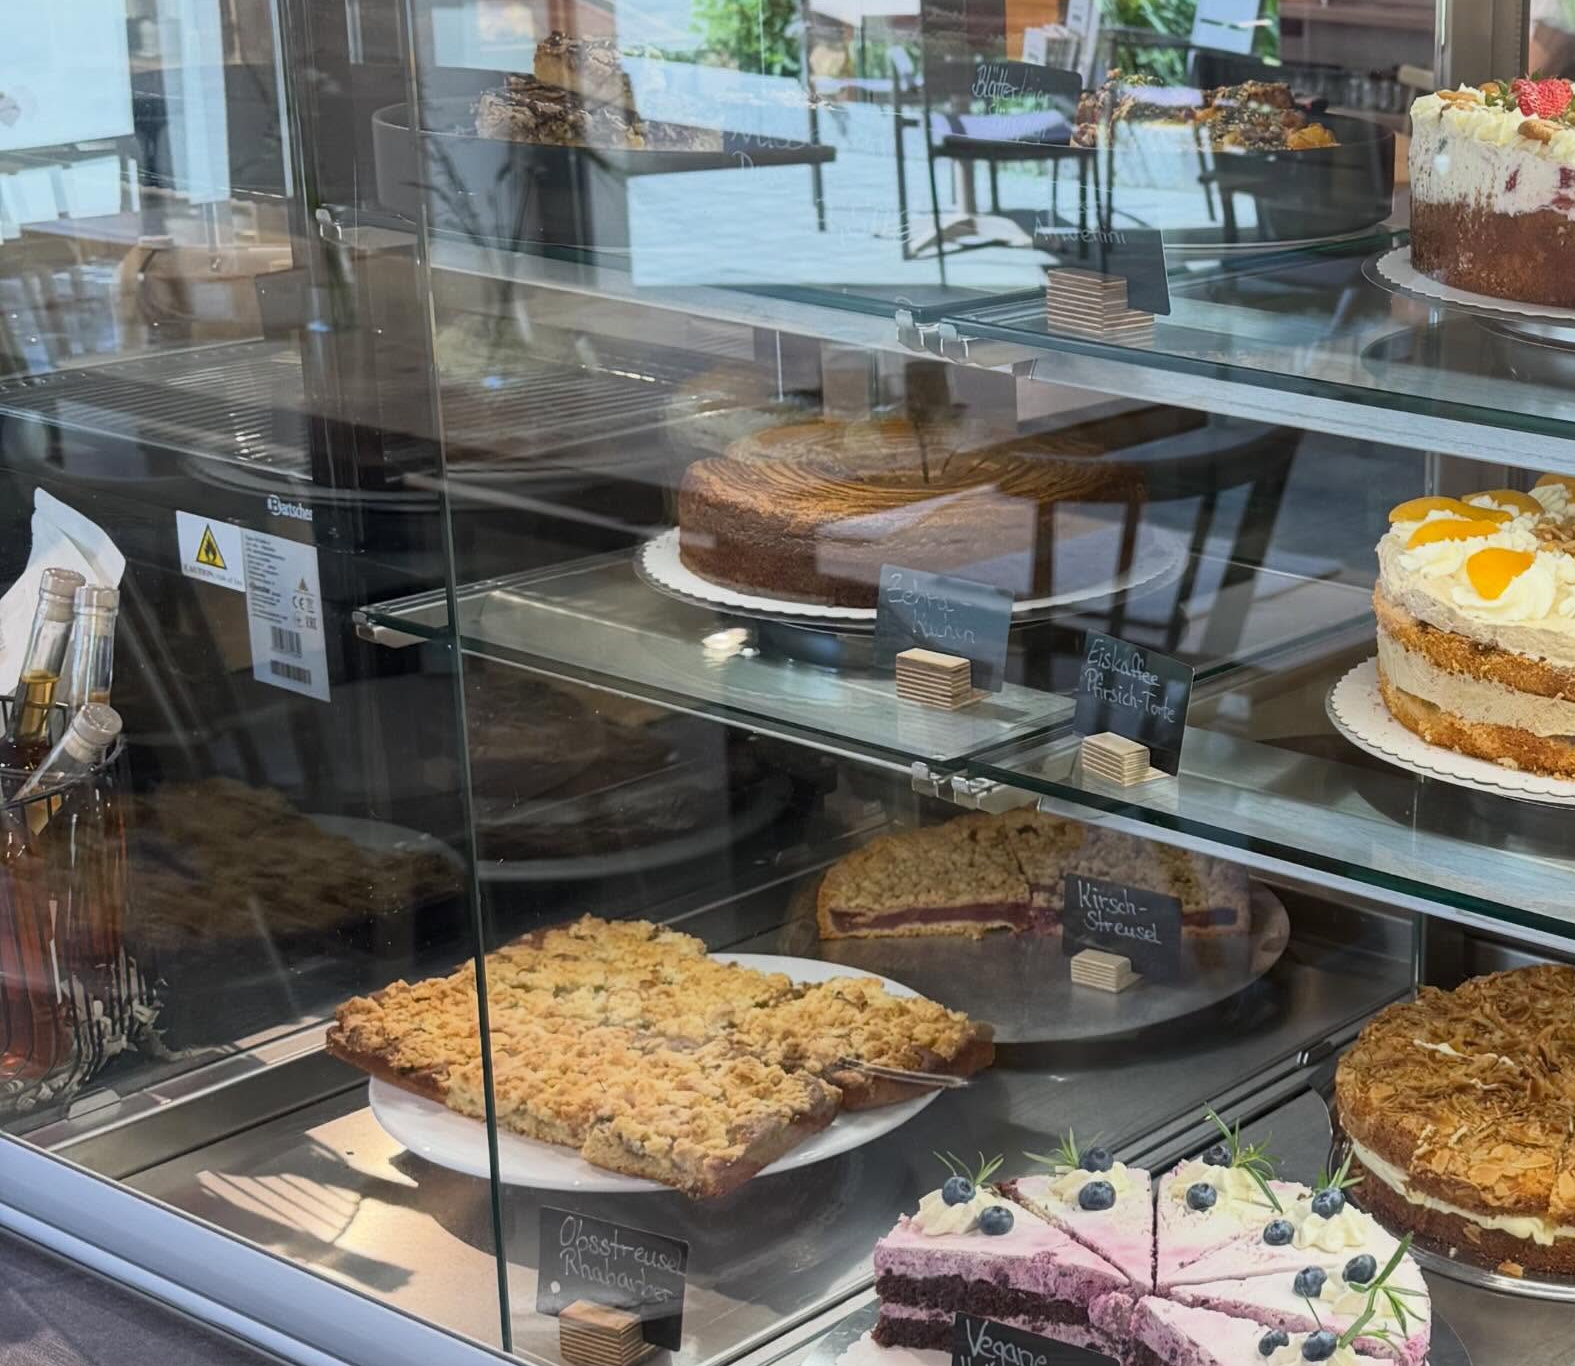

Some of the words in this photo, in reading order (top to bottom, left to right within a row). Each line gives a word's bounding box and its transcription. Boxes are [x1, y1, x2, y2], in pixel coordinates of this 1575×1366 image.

[1085, 637, 1161, 688] Eiskaffee
[1085, 667, 1178, 725] Pfirsich-Torte
[1077, 879, 1149, 917] Kirsch-
[1083, 909, 1164, 946] Streusel
